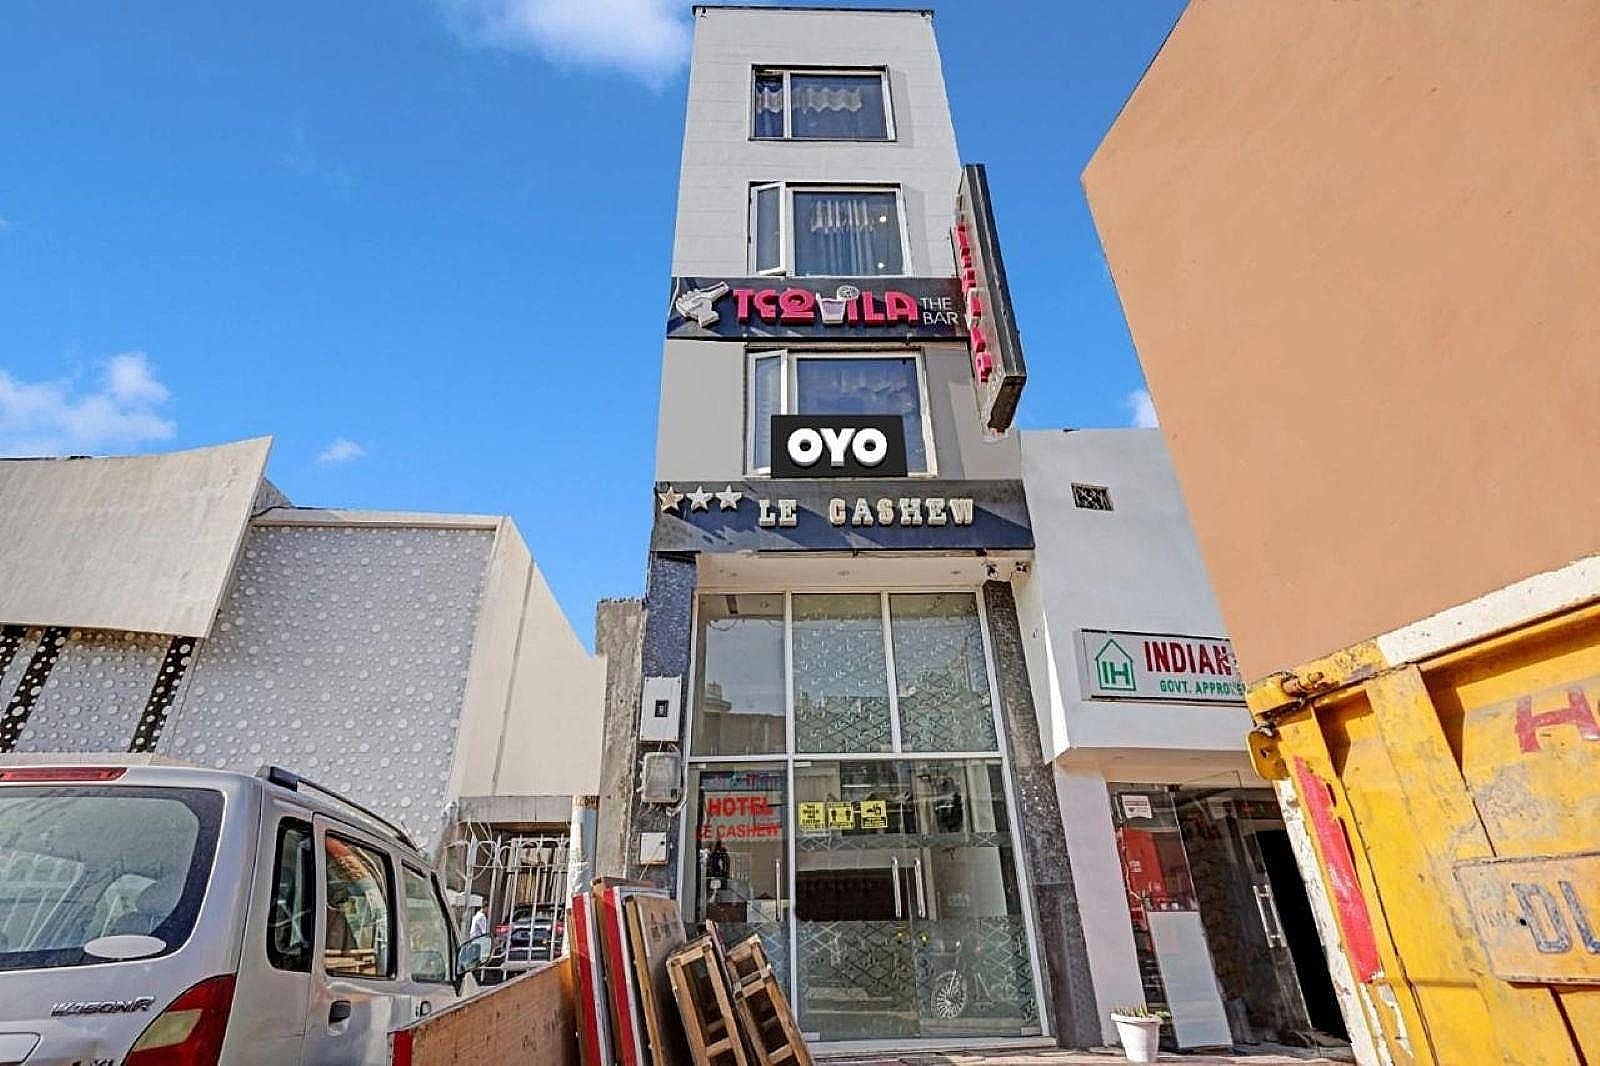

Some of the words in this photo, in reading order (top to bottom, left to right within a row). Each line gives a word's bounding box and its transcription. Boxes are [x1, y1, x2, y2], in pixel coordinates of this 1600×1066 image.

[920, 297, 952, 312] THE
[922, 312, 959, 326] BAR
[787, 427, 888, 467] OYO
[758, 499, 798, 527] LE
[828, 497, 976, 527] CASHEW
[1159, 680, 1193, 694] GOVT.
[1195, 680, 1246, 697] APPROE
[707, 796, 773, 817] HOTEL
